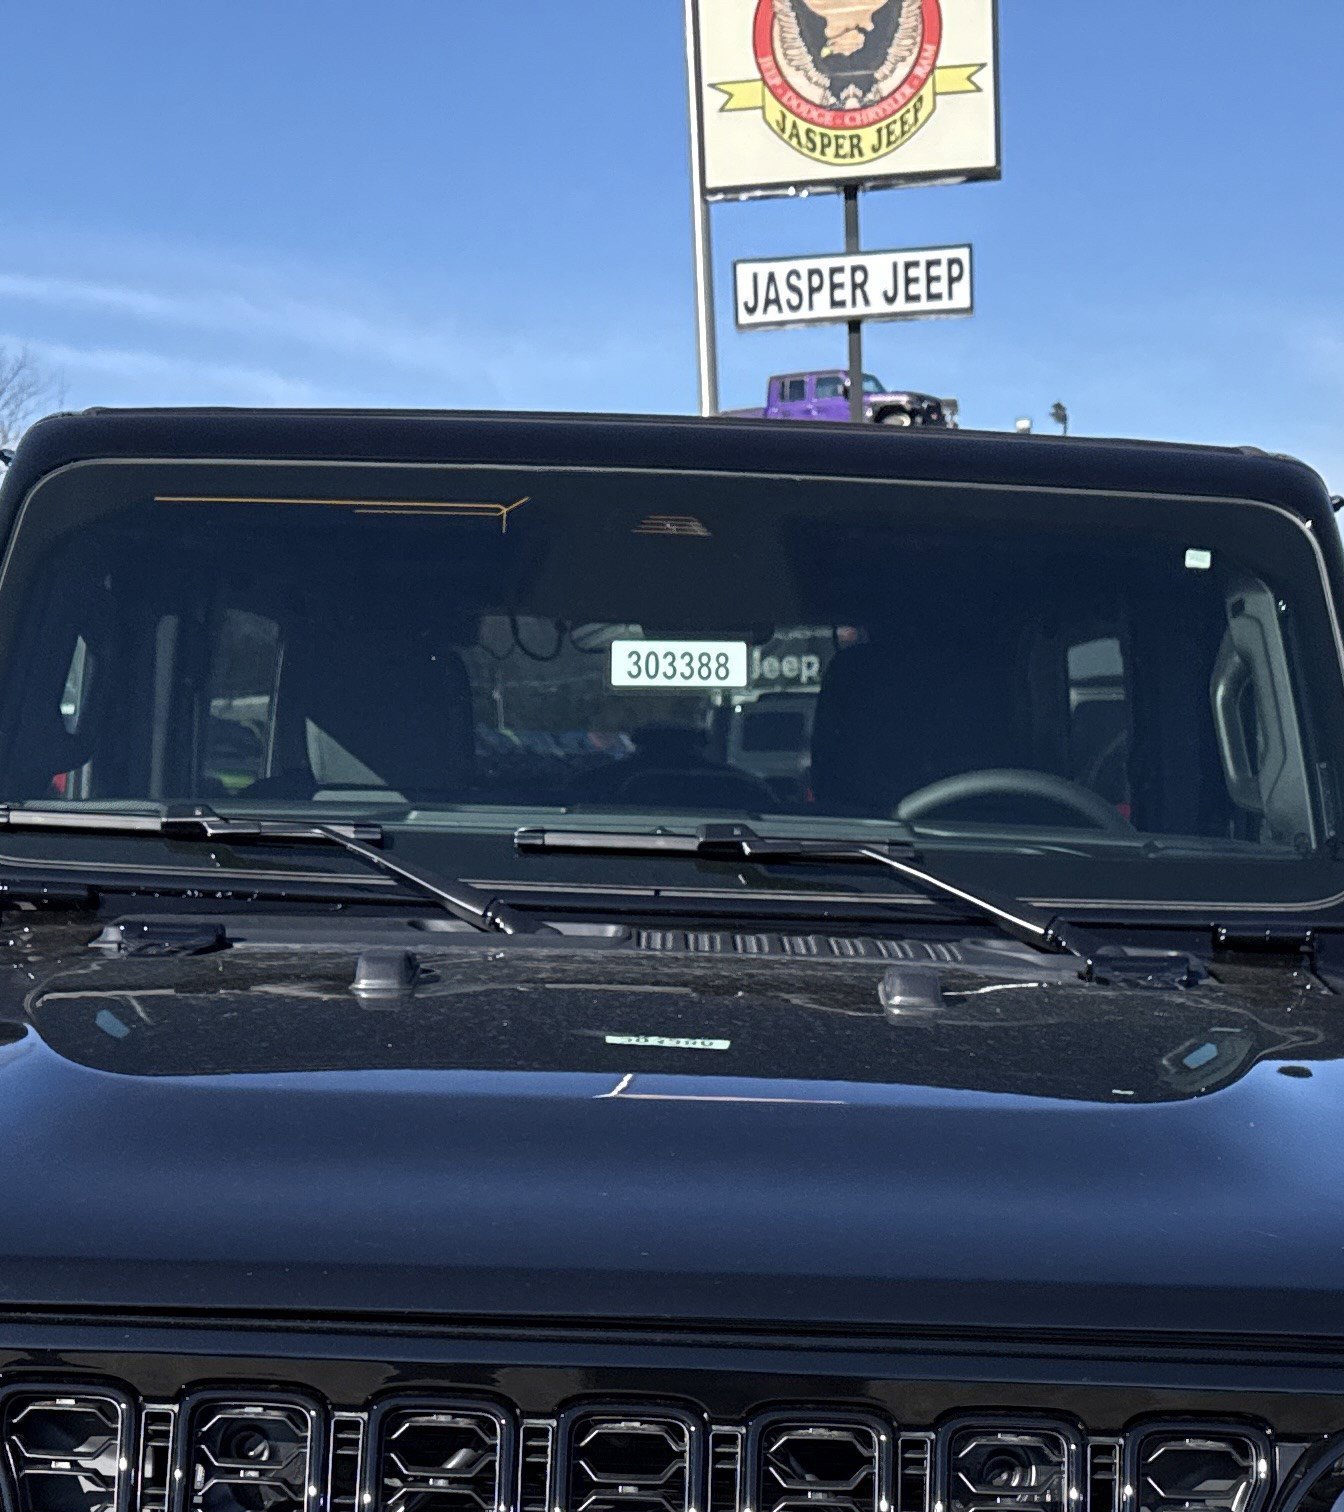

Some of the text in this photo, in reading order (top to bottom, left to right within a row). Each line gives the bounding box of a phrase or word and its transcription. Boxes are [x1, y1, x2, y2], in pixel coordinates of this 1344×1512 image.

[775, 94, 924, 159] JASPER JEEP
[743, 256, 966, 316] JASPER JEEP
[627, 651, 731, 680] 303388
